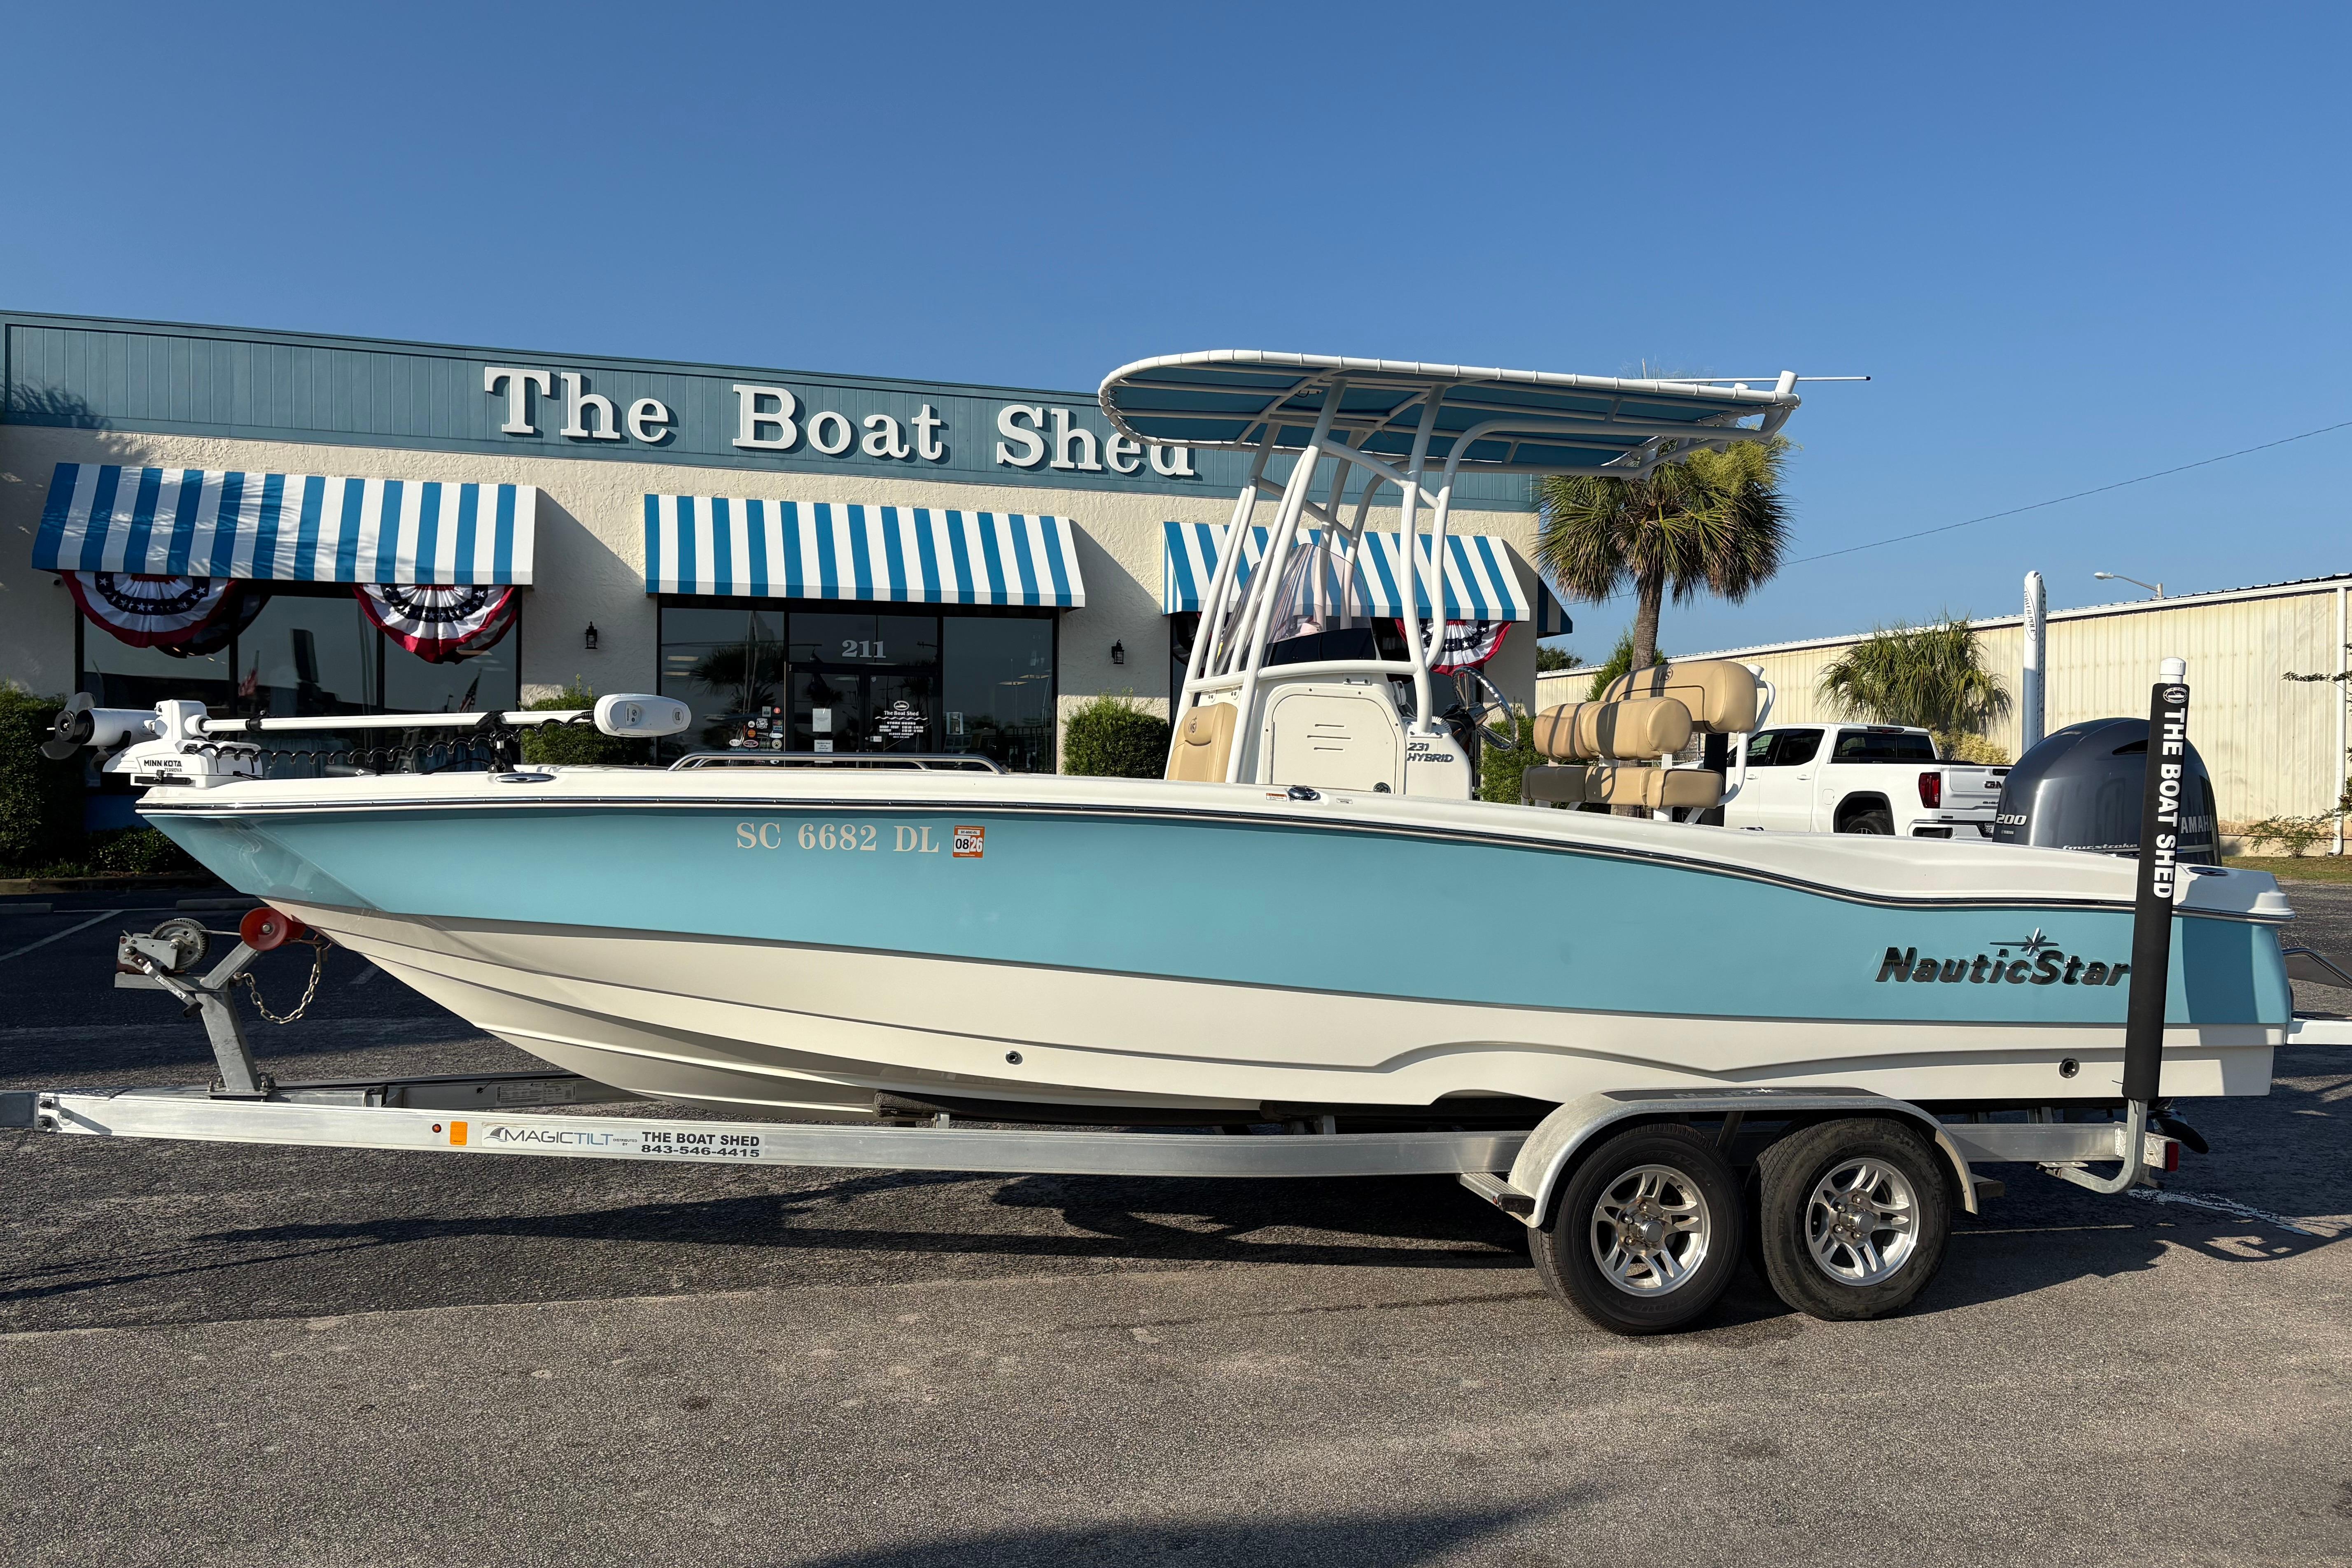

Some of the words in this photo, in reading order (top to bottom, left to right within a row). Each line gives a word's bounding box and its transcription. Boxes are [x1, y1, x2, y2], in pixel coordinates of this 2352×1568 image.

[484, 367, 669, 443] The
[732, 384, 943, 460] Boat
[996, 404, 1195, 477] Shed
[841, 639, 887, 659] 211
[2163, 708, 2185, 756] THE
[1407, 742, 1429, 751] 231
[1407, 753, 1454, 762] HYBRID
[2159, 763, 2182, 827] BOAT
[1996, 814, 2027, 825] 200
[2179, 815, 2213, 833] AMAHA
[736, 822, 782, 850] SC
[798, 824, 877, 852] 6682
[893, 826, 939, 853] DL
[956, 839, 969, 849] 08
[970, 837, 983, 852] 26
[2154, 834, 2176, 898] SHED
[1875, 946, 2130, 987] NauticStar
[505, 1129, 614, 1146] MAGICTILT
[642, 1132, 671, 1143] THE
[676, 1133, 716, 1145] BOAT
[720, 1135, 760, 1146] SHED
[641, 1145, 760, 1157] 843-546-4415
